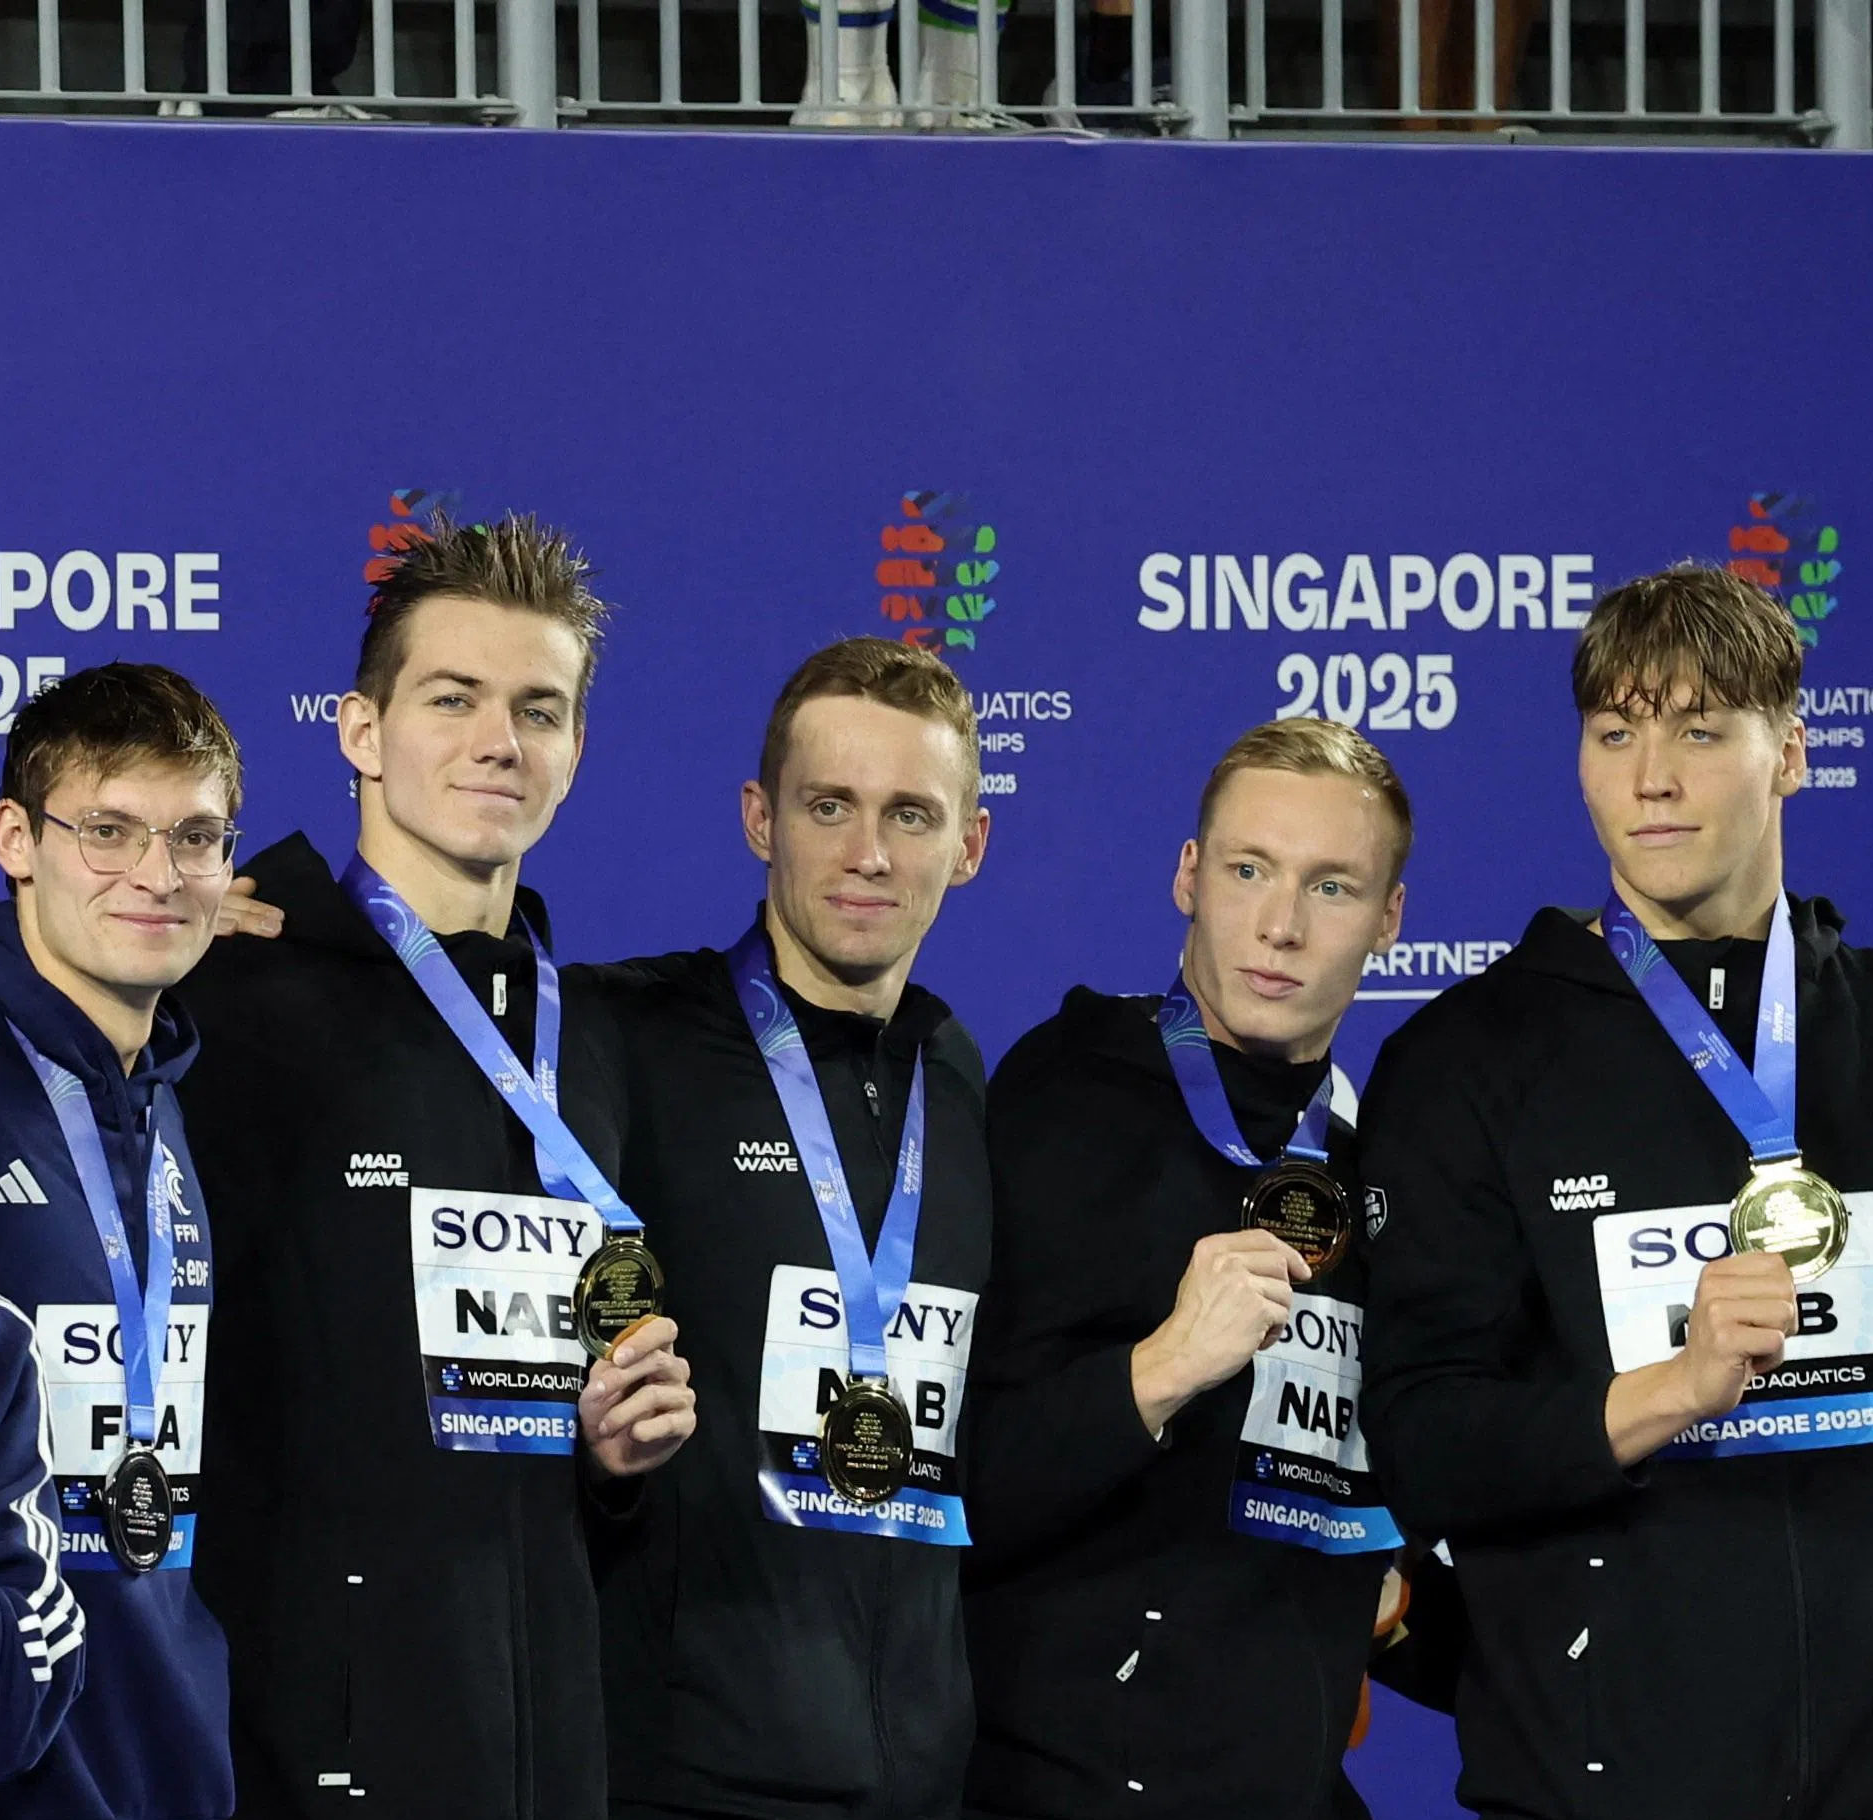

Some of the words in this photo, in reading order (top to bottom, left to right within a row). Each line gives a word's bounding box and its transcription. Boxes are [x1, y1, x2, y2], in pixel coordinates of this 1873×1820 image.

[1137, 551, 1594, 633] SINGAPORE
[969, 690, 1073, 720] UATICS
[1276, 652, 1457, 731] 2025
[1361, 940, 1515, 977] ARTNER
[349, 1153, 402, 1169] MAD
[738, 1142, 790, 1156] MAD
[733, 1157, 799, 1172] WAVE
[344, 1172, 409, 1188] WAVE
[1553, 1175, 1608, 1194] MAD
[1549, 1190, 1616, 1211] WAVE
[173, 1224, 200, 1243] FFN
[431, 1207, 589, 1258] SONY
[1629, 1221, 1733, 1270] SO
[455, 1288, 576, 1340] NAB
[799, 1288, 963, 1345] SNY
[468, 1370, 530, 1388] WORLD
[1768, 1366, 1866, 1388] AQUATICS
[816, 1367, 946, 1430] NB
[1277, 1381, 1354, 1441] NAB
[91, 1404, 181, 1451] FA
[441, 1412, 564, 1438] SINGAPORE
[1673, 1413, 1810, 1444] NGAPORE
[1278, 1461, 1323, 1484] WORLD
[171, 1487, 190, 1502] TICS
[1244, 1498, 1324, 1531] SINGAPO
